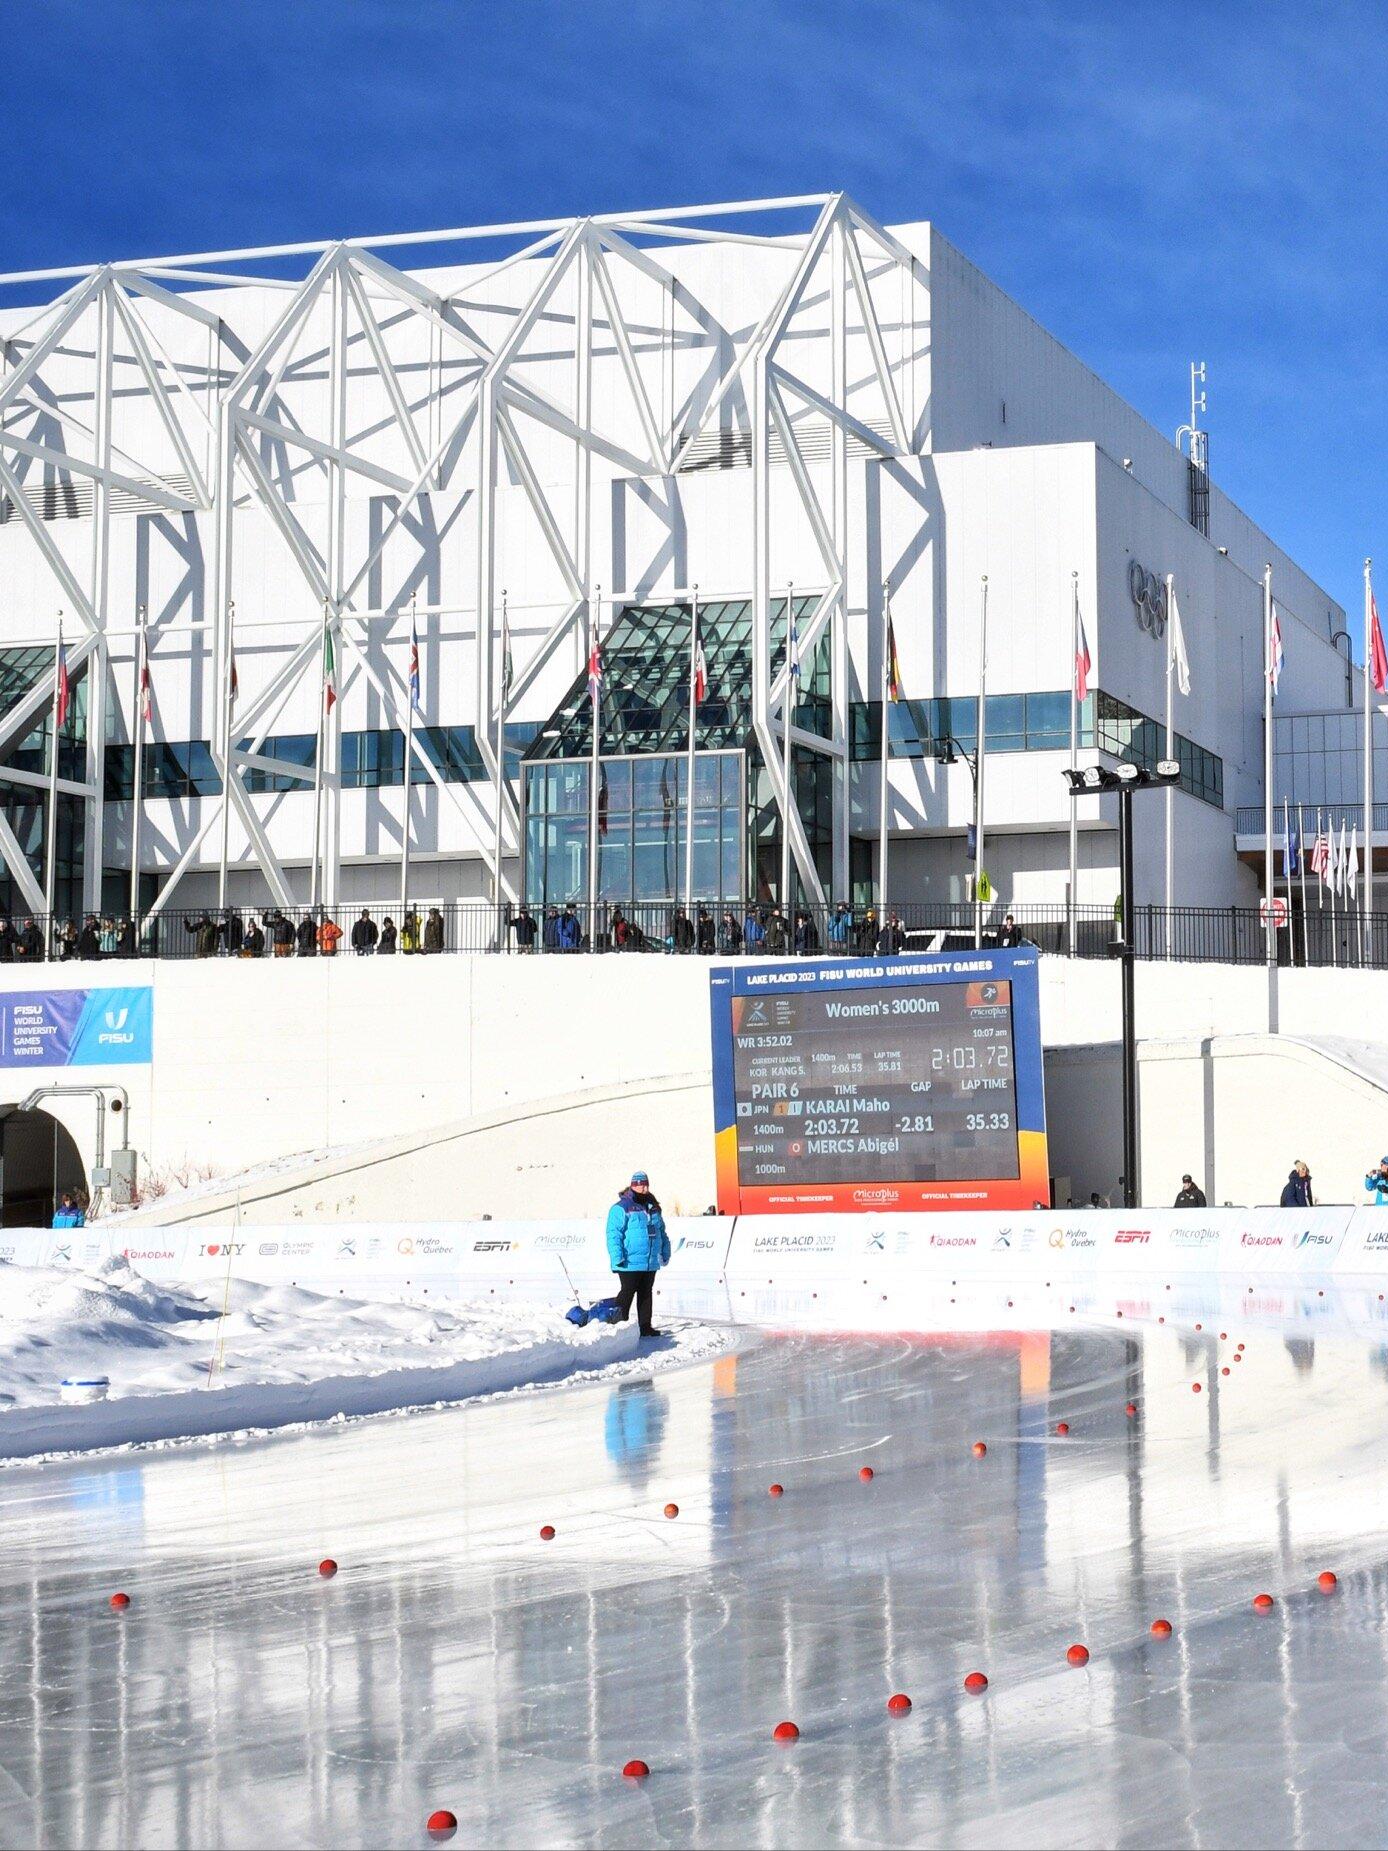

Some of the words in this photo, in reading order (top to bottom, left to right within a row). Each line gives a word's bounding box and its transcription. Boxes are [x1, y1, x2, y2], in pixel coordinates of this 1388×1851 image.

[747, 974, 770, 985] LAKE
[798, 971, 816, 982] 2023
[819, 970, 844, 981] FISU
[845, 967, 884, 979] WORLD
[886, 963, 952, 977] UNIVERSITY
[953, 960, 993, 972] GAMES
[13, 1005, 42, 1015] FISU
[825, 1001, 890, 1018] Women's
[891, 998, 940, 1015] 3000m
[13, 1016, 44, 1025] WORLD
[13, 1026, 58, 1035] UNIVERSITY
[972, 1028, 994, 1038] 10:07
[13, 1036, 41, 1046] GAMES
[98, 1033, 134, 1045] FISU
[737, 1038, 755, 1049] WR
[757, 1035, 793, 1047] 3:52.02
[13, 1046, 44, 1055] WINTER
[752, 1057, 778, 1065] CURRENT
[779, 1055, 801, 1064] LEADER
[811, 1053, 836, 1063] 1400m
[932, 1045, 1009, 1070] 2:03.72
[749, 1068, 767, 1077] KOR
[771, 1066, 797, 1076] KANG
[831, 1063, 863, 1074] 2:06.53
[878, 1061, 902, 1072] 35.81
[833, 1084, 858, 1095] TIME
[910, 1081, 932, 1092] GAP
[961, 1079, 981, 1090] LAP
[982, 1078, 1008, 1089] TIME
[752, 1083, 788, 1099] PAIR
[790, 1081, 800, 1097] 6
[753, 1105, 769, 1115] JPN
[805, 1099, 850, 1114] KARAI
[853, 1097, 890, 1113] Maho
[753, 1124, 784, 1135] 1400m
[804, 1118, 860, 1136] 2:03.72
[895, 1115, 934, 1133] -2.81
[966, 1113, 1009, 1131] 35.33
[755, 1144, 774, 1154] HUN
[807, 1139, 855, 1154] MERCS
[857, 1136, 899, 1155] Abigél
[755, 1164, 786, 1175] 1000m
[1065, 1230, 1087, 1240] Hydro
[1114, 1230, 1151, 1243] ESPN
[1306, 1235, 1333, 1245] FISU
[416, 1237, 440, 1247] Hydro
[685, 1240, 715, 1249] FISU
[755, 1236, 778, 1247] LAKE
[780, 1236, 814, 1247] PLACID
[815, 1235, 836, 1246] 2023
[936, 1236, 976, 1246] QIAODAN
[1246, 1236, 1283, 1246] QIAODAN
[130, 1251, 175, 1260] QIAODAN
[198, 1243, 207, 1257] I
[221, 1243, 247, 1256] NY
